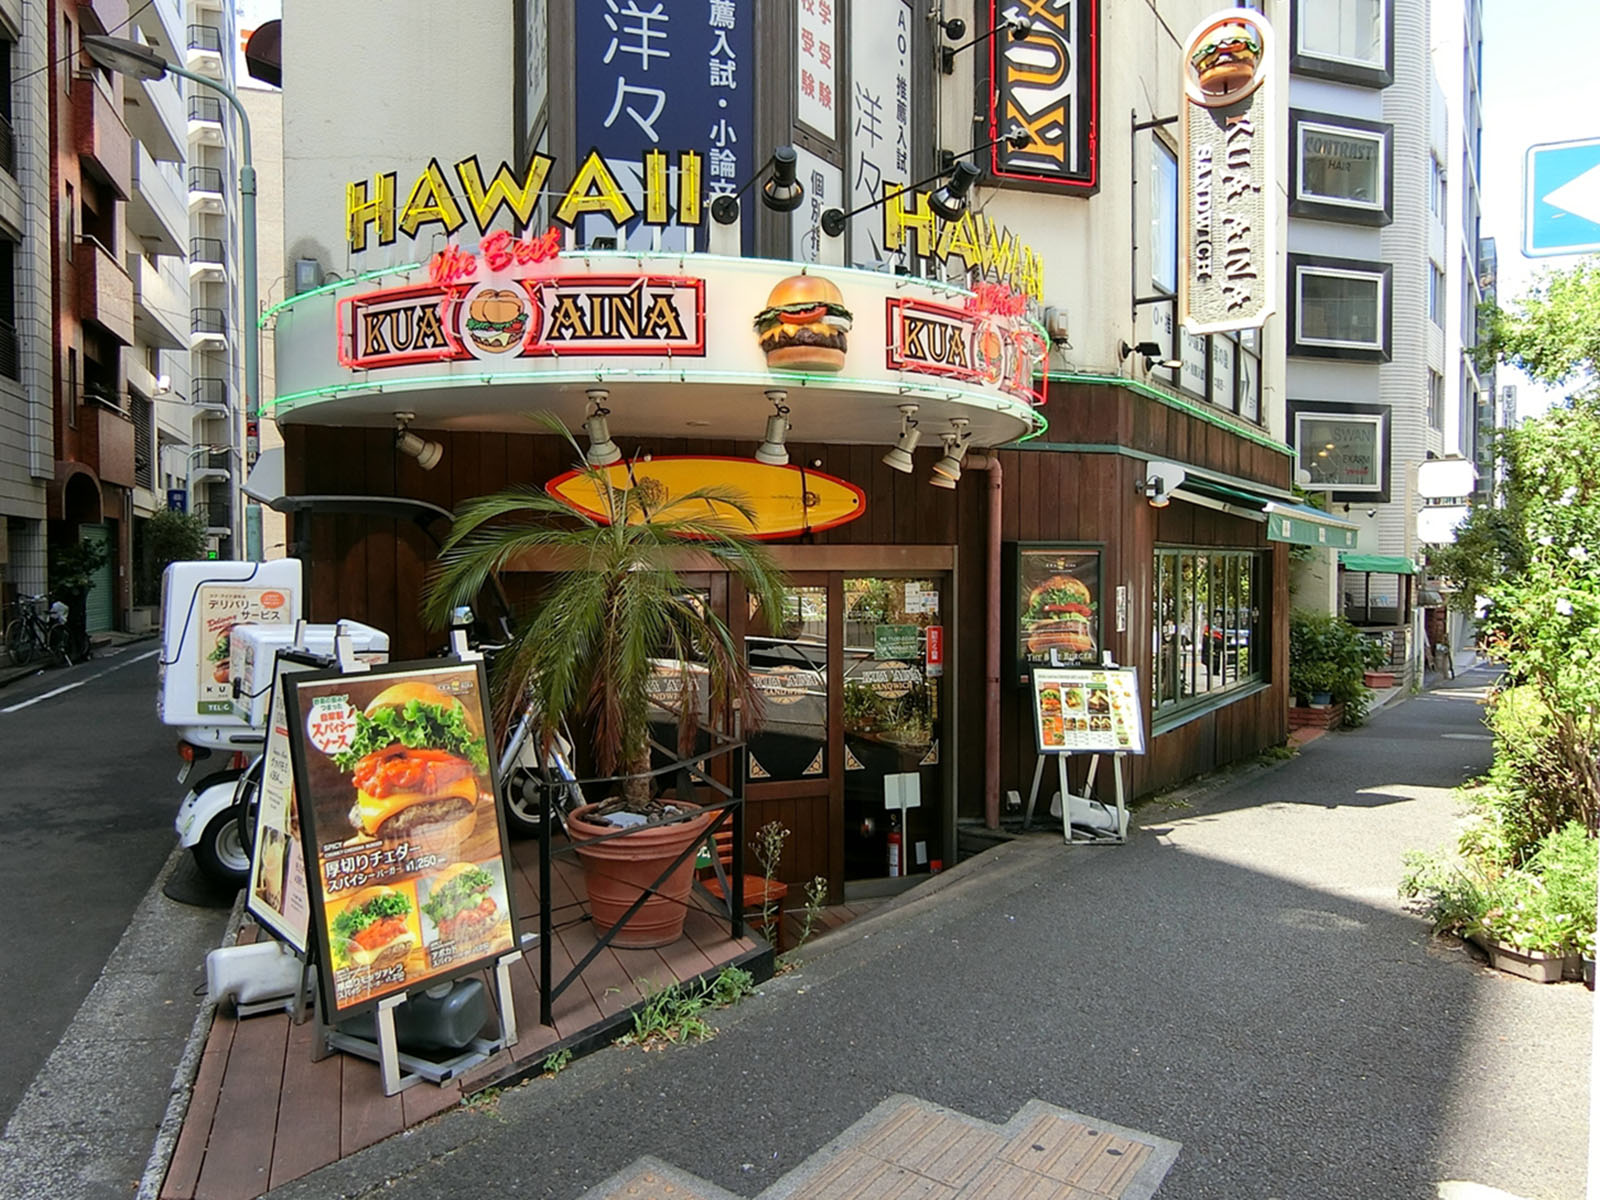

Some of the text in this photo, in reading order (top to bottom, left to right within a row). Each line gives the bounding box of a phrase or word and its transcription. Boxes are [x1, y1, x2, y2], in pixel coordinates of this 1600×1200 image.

[346, 148, 703, 254] HAWAII
[1195, 144, 1213, 283] SANDWICH
[479, 226, 561, 273] Best
[364, 303, 449, 357] KUA
[903, 316, 969, 369] KUA
[208, 600, 259, 610] デリバリー
[241, 611, 281, 620] サービス
[312, 721, 355, 738] スパイシー
[319, 735, 349, 752] ソース
[325, 842, 421, 878] 厚切りチェダー
